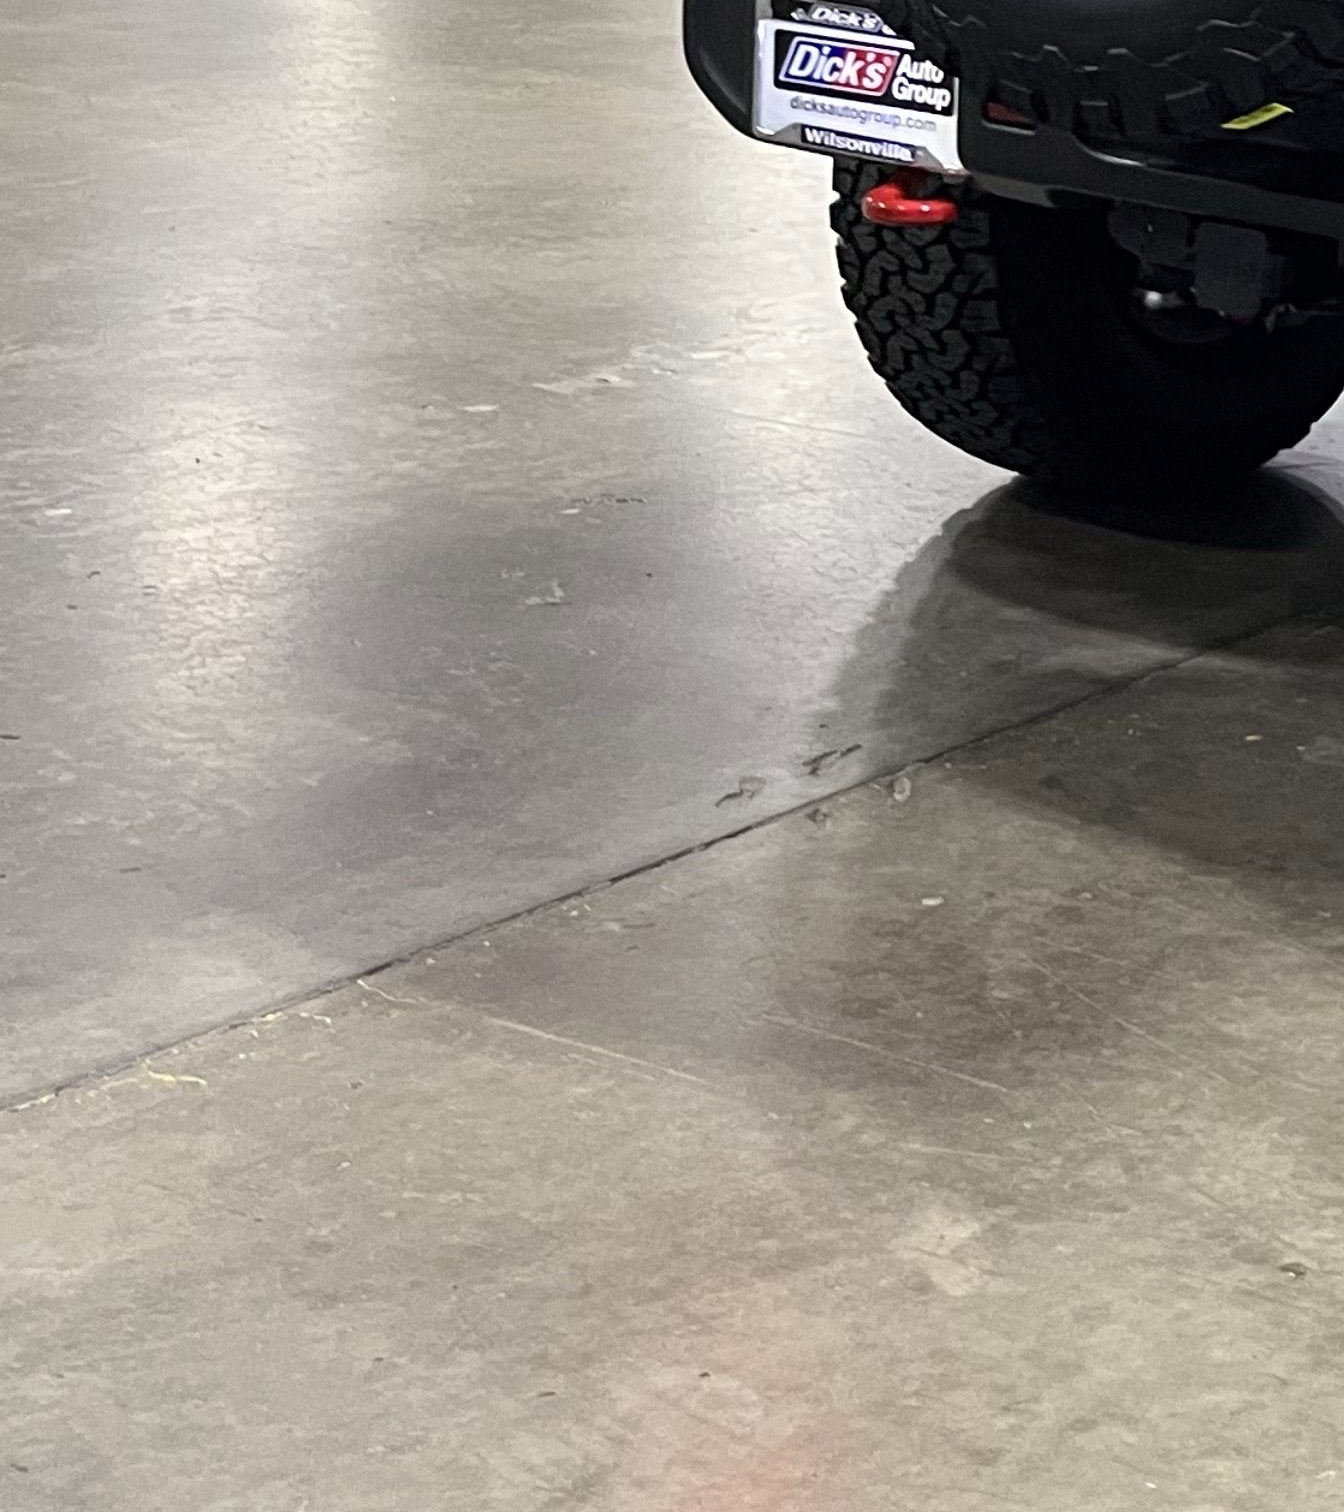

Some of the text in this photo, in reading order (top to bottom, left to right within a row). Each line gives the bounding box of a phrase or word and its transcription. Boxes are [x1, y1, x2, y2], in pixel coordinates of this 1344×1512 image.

[788, 43, 892, 89] Dick's
[896, 53, 945, 84] Auto
[891, 76, 952, 111] Group
[790, 95, 937, 131] dicksautogroup.com
[804, 127, 914, 162] Wilsonville
